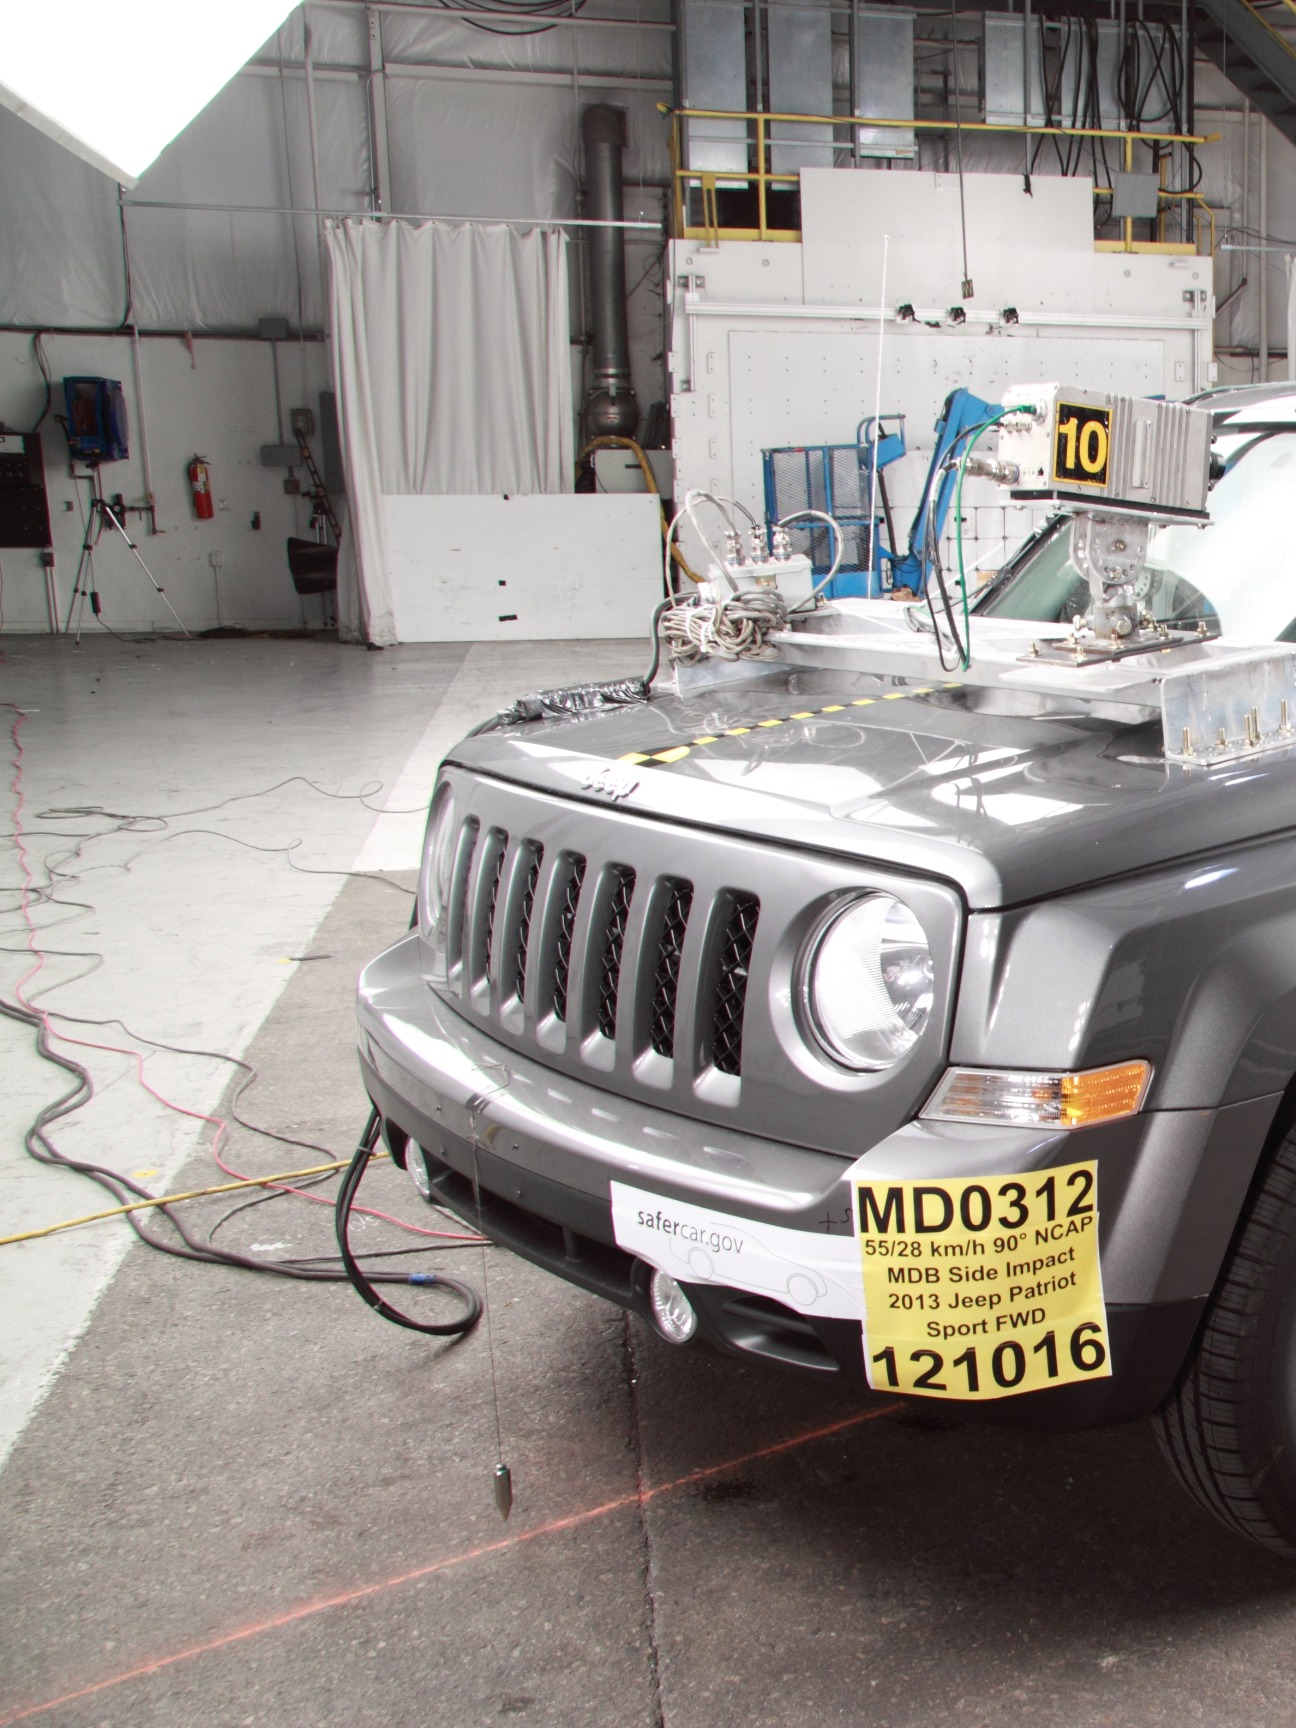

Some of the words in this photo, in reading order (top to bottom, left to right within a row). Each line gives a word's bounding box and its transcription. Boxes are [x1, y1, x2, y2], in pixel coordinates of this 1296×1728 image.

[1058, 416, 1108, 474] 10
[857, 1169, 1094, 1235] MD0312
[637, 1210, 744, 1254] safercar.gov
[865, 1238, 923, 1257] 55/28
[930, 1239, 985, 1258] km/h
[993, 1232, 1027, 1254] 90°
[1035, 1215, 1093, 1246] NCAP
[887, 1266, 940, 1284] MDB
[949, 1265, 998, 1284] Side
[1006, 1246, 1075, 1278] Impact
[889, 1293, 940, 1310] 2013
[948, 1292, 1002, 1310] Jeep
[1009, 1271, 1077, 1303] Patriot
[926, 1318, 988, 1340] Sport
[996, 1307, 1046, 1332] FWD
[872, 1321, 1106, 1393] 121016
